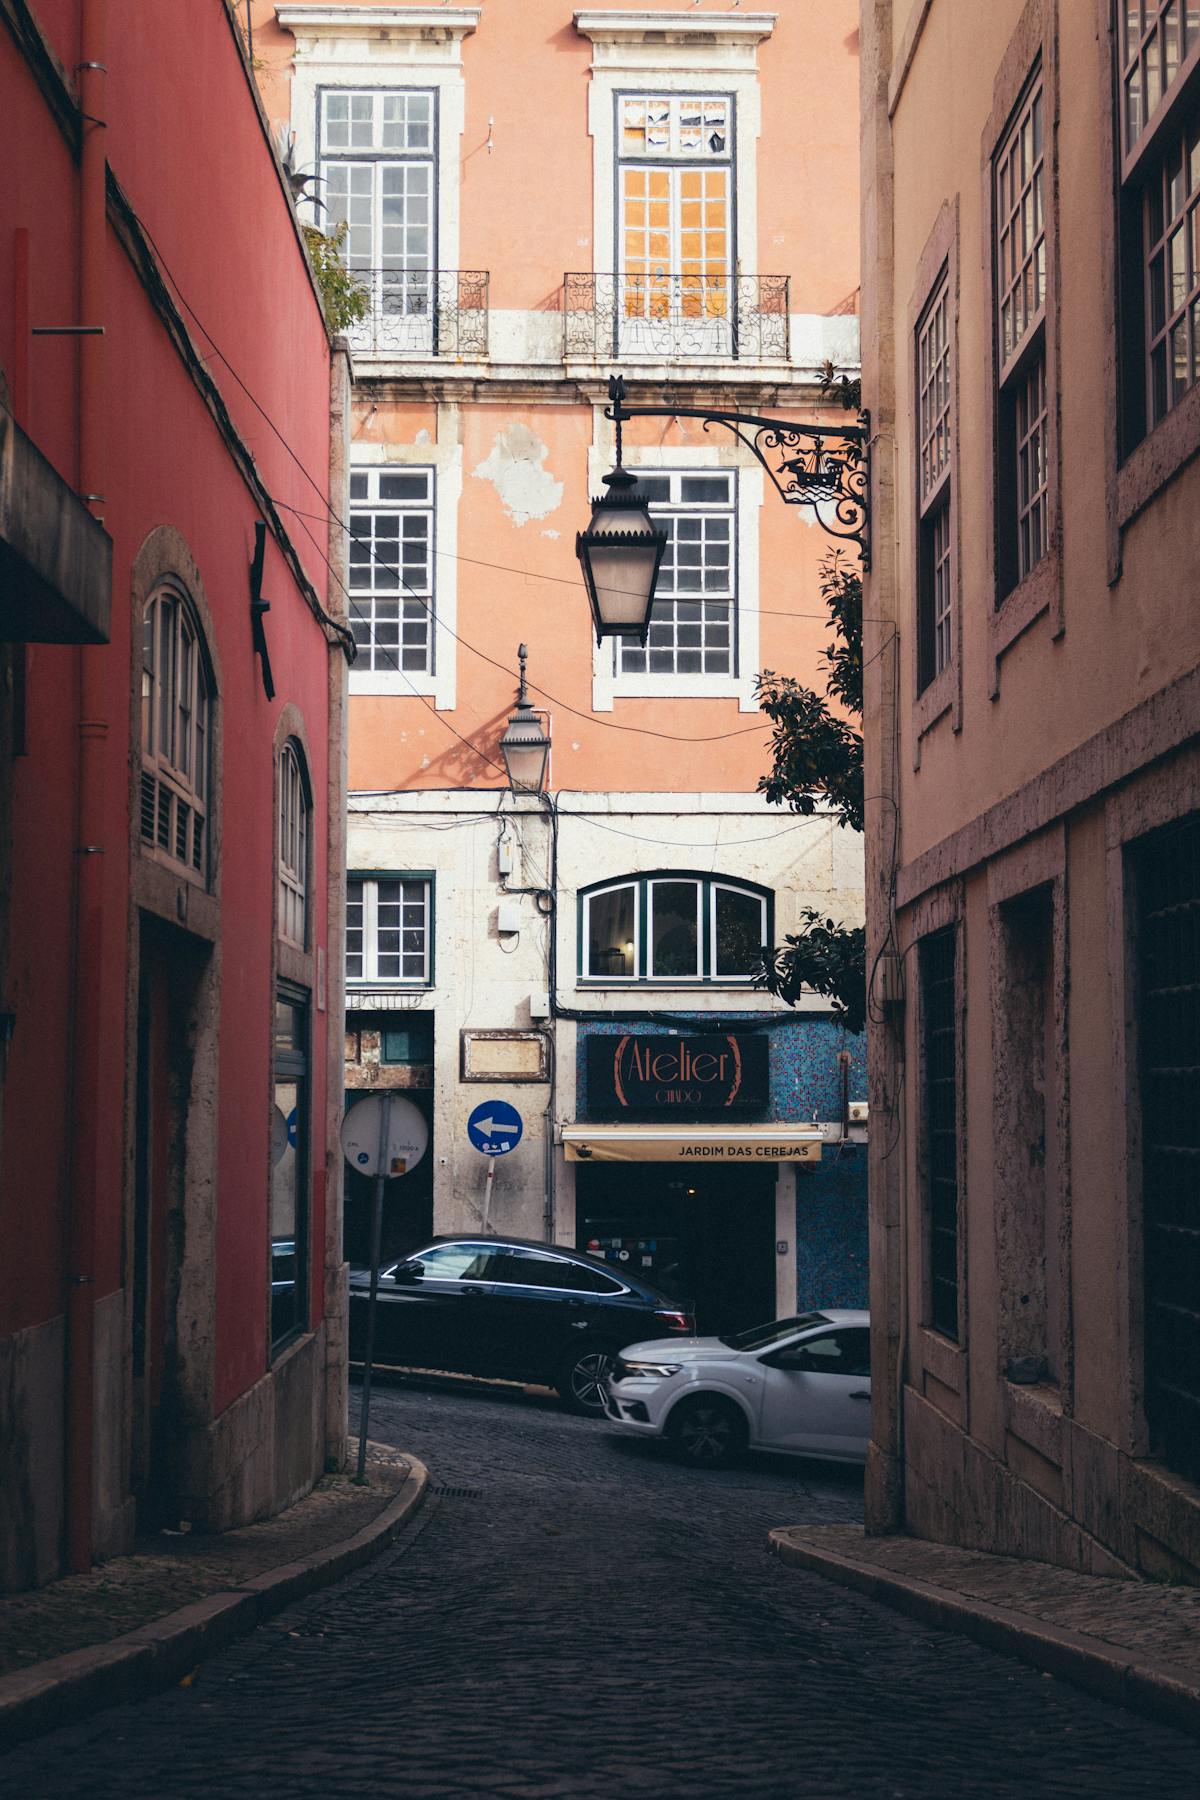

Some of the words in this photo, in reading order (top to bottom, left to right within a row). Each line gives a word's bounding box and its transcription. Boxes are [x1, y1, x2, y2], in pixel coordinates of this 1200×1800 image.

[679, 1146, 724, 1156] JARDIM
[727, 1146, 752, 1156] DAS
[755, 1146, 809, 1156] CEREJAS
